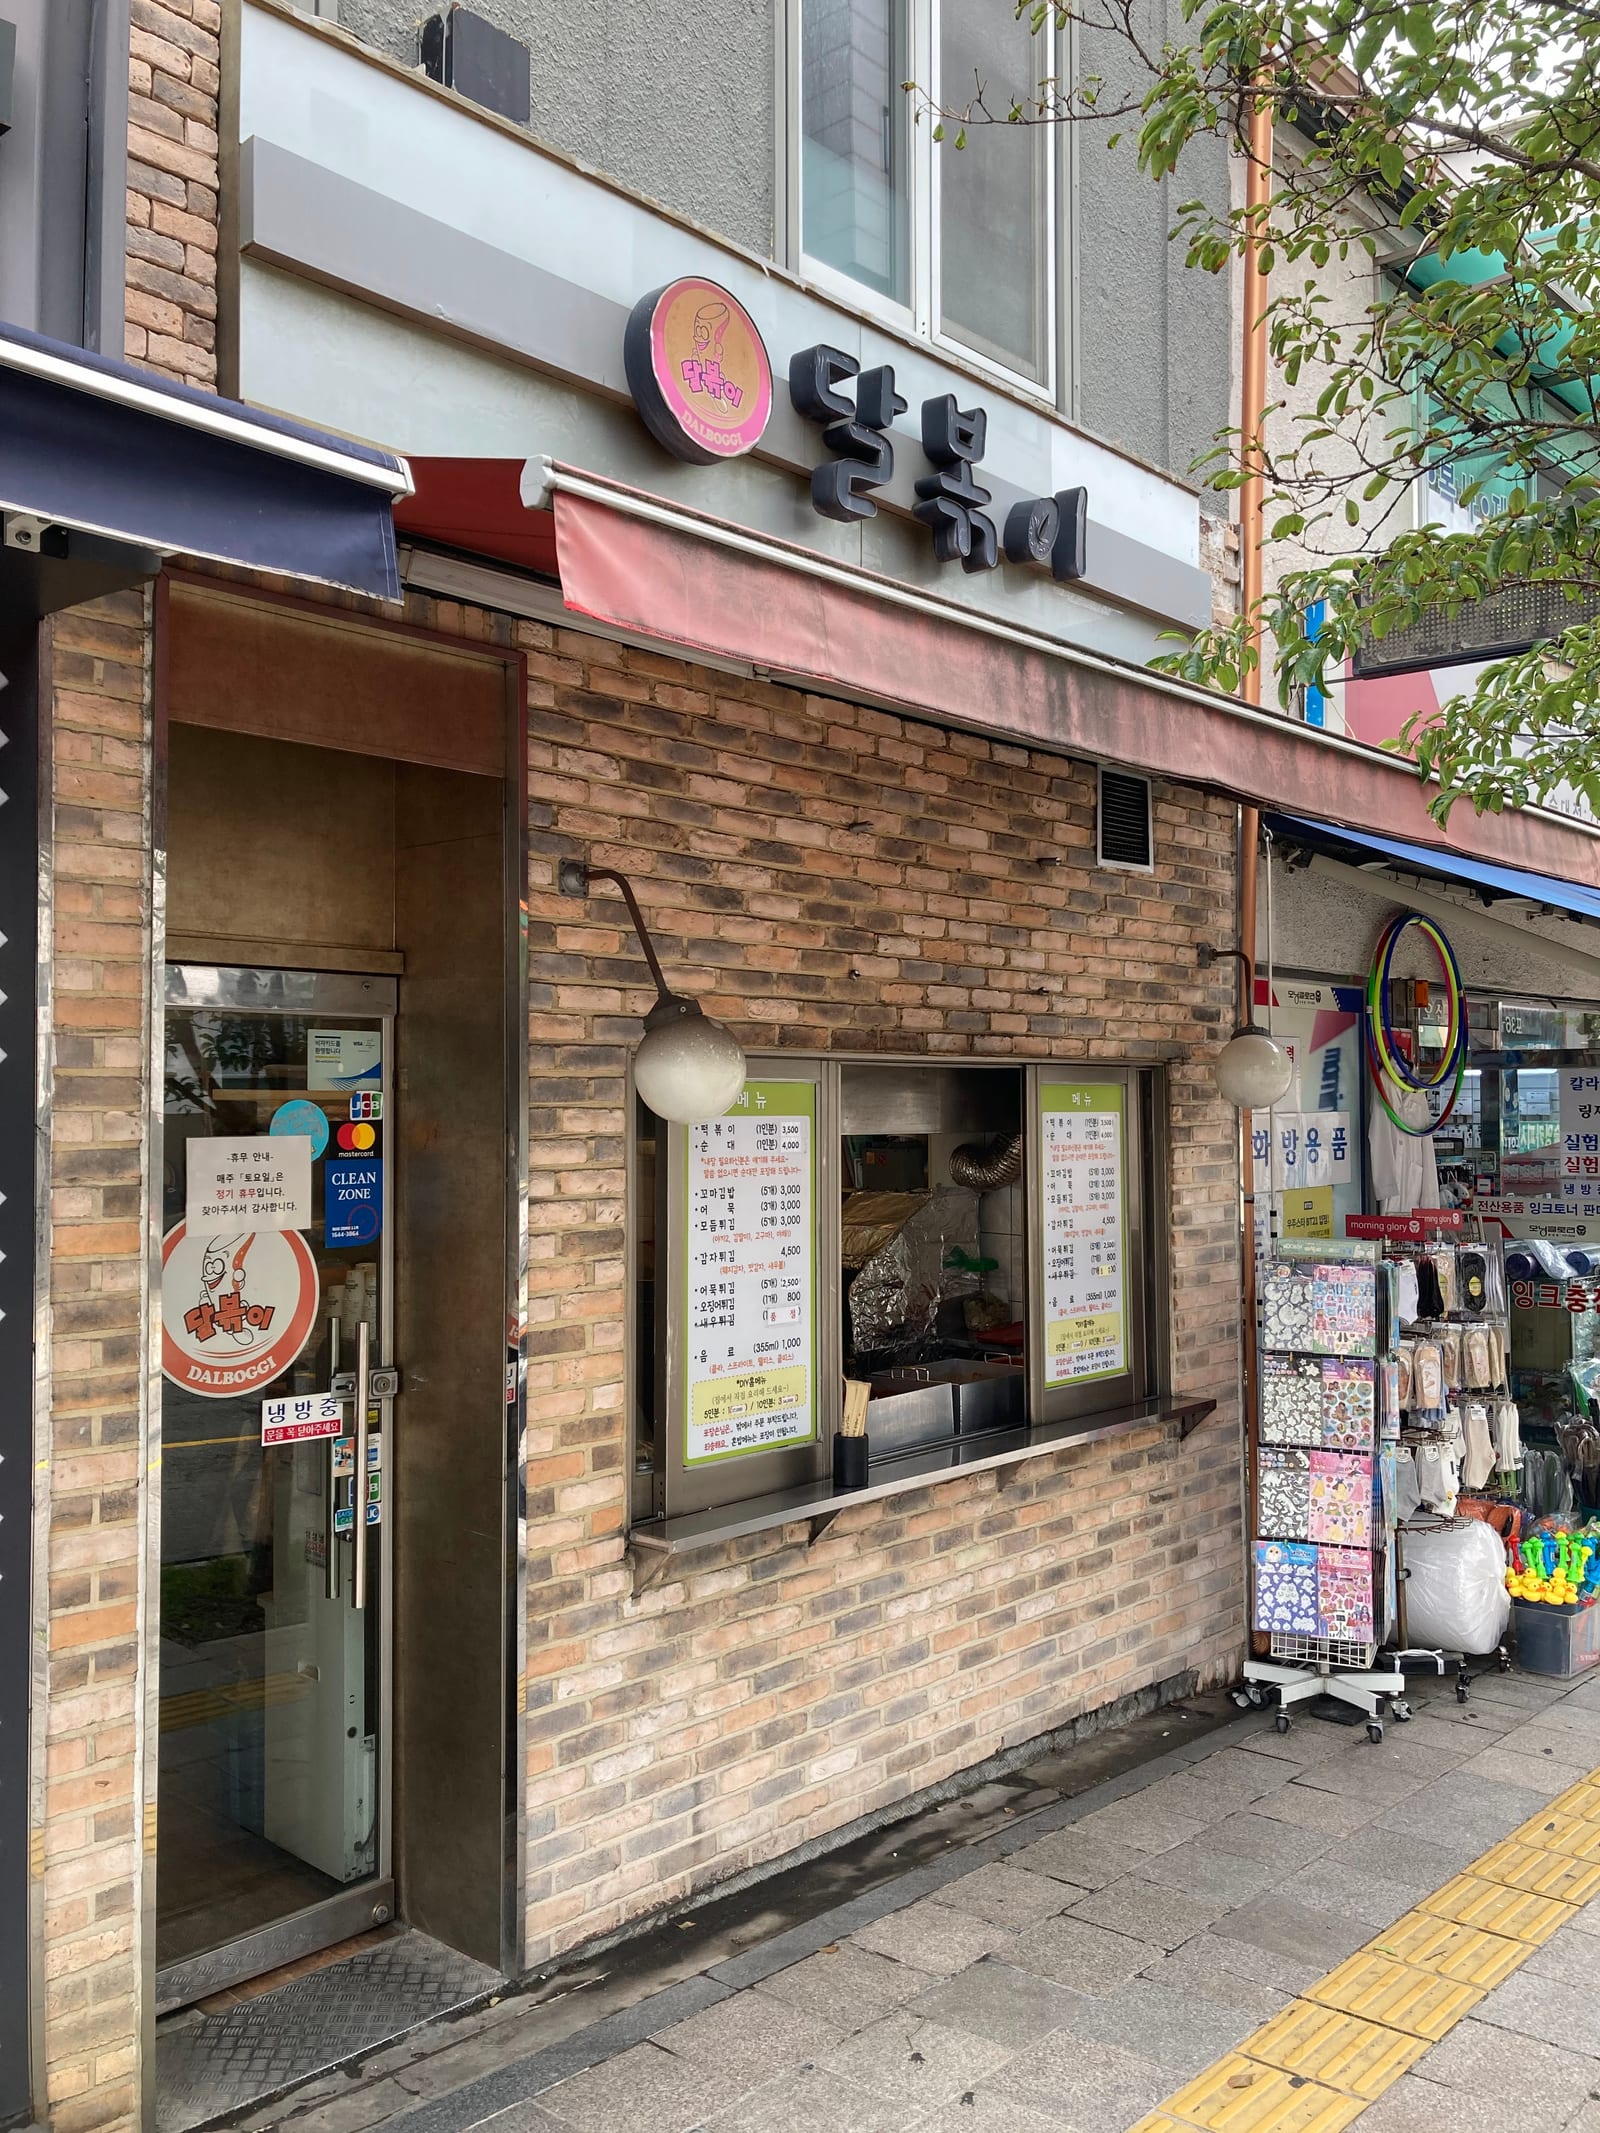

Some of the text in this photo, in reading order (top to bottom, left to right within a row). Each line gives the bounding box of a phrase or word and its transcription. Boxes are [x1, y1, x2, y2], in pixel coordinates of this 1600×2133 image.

[681, 359, 743, 408] 달볶이
[681, 411, 743, 446] DALBOGGI
[789, 343, 1088, 583] 달볶이
[351, 1101, 380, 1110] JCB
[756, 1122, 778, 1135] (1인분)
[782, 1125, 798, 1134] 3,500
[756, 1139, 778, 1151] (1인분)
[782, 1140, 799, 1150] 4,000
[216, 1173, 234, 1183] 매주
[331, 1172, 376, 1185] CLEAN
[216, 1187, 285, 1199] 정기 휴무입니다.
[338, 1188, 371, 1200] ZONE
[700, 1184, 800, 1200] 꼬마김밥 (5개) 3,000
[202, 1201, 297, 1216] 찾아주셔서 감사합니다.
[760, 1201, 777, 1212] (3개)
[780, 1199, 800, 1210] 3,000
[1478, 1200, 1524, 1214] 전산용품
[1529, 1202, 1578, 1216] 잉크토너
[700, 1214, 800, 1232] 모듬튀김 (5개) 3,000
[1102, 1215, 1115, 1225] 4,500
[1350, 1221, 1407, 1233] morning glory
[700, 1245, 800, 1265] 감자튀김 4,500
[1106, 1253, 1116, 1261] 800
[700, 1278, 799, 1296] 어묵튀김 (5개) 2,500
[700, 1291, 801, 1312] 오징어튀김 (1개) 800
[183, 1291, 275, 1344] 달볶이
[753, 1340, 779, 1353] (355ml)
[781, 1337, 801, 1349] 1,000
[186, 1356, 277, 1385] DALBOGGI
[266, 1429, 284, 1441] 문을
[298, 1422, 339, 1437] 닫아주세요
